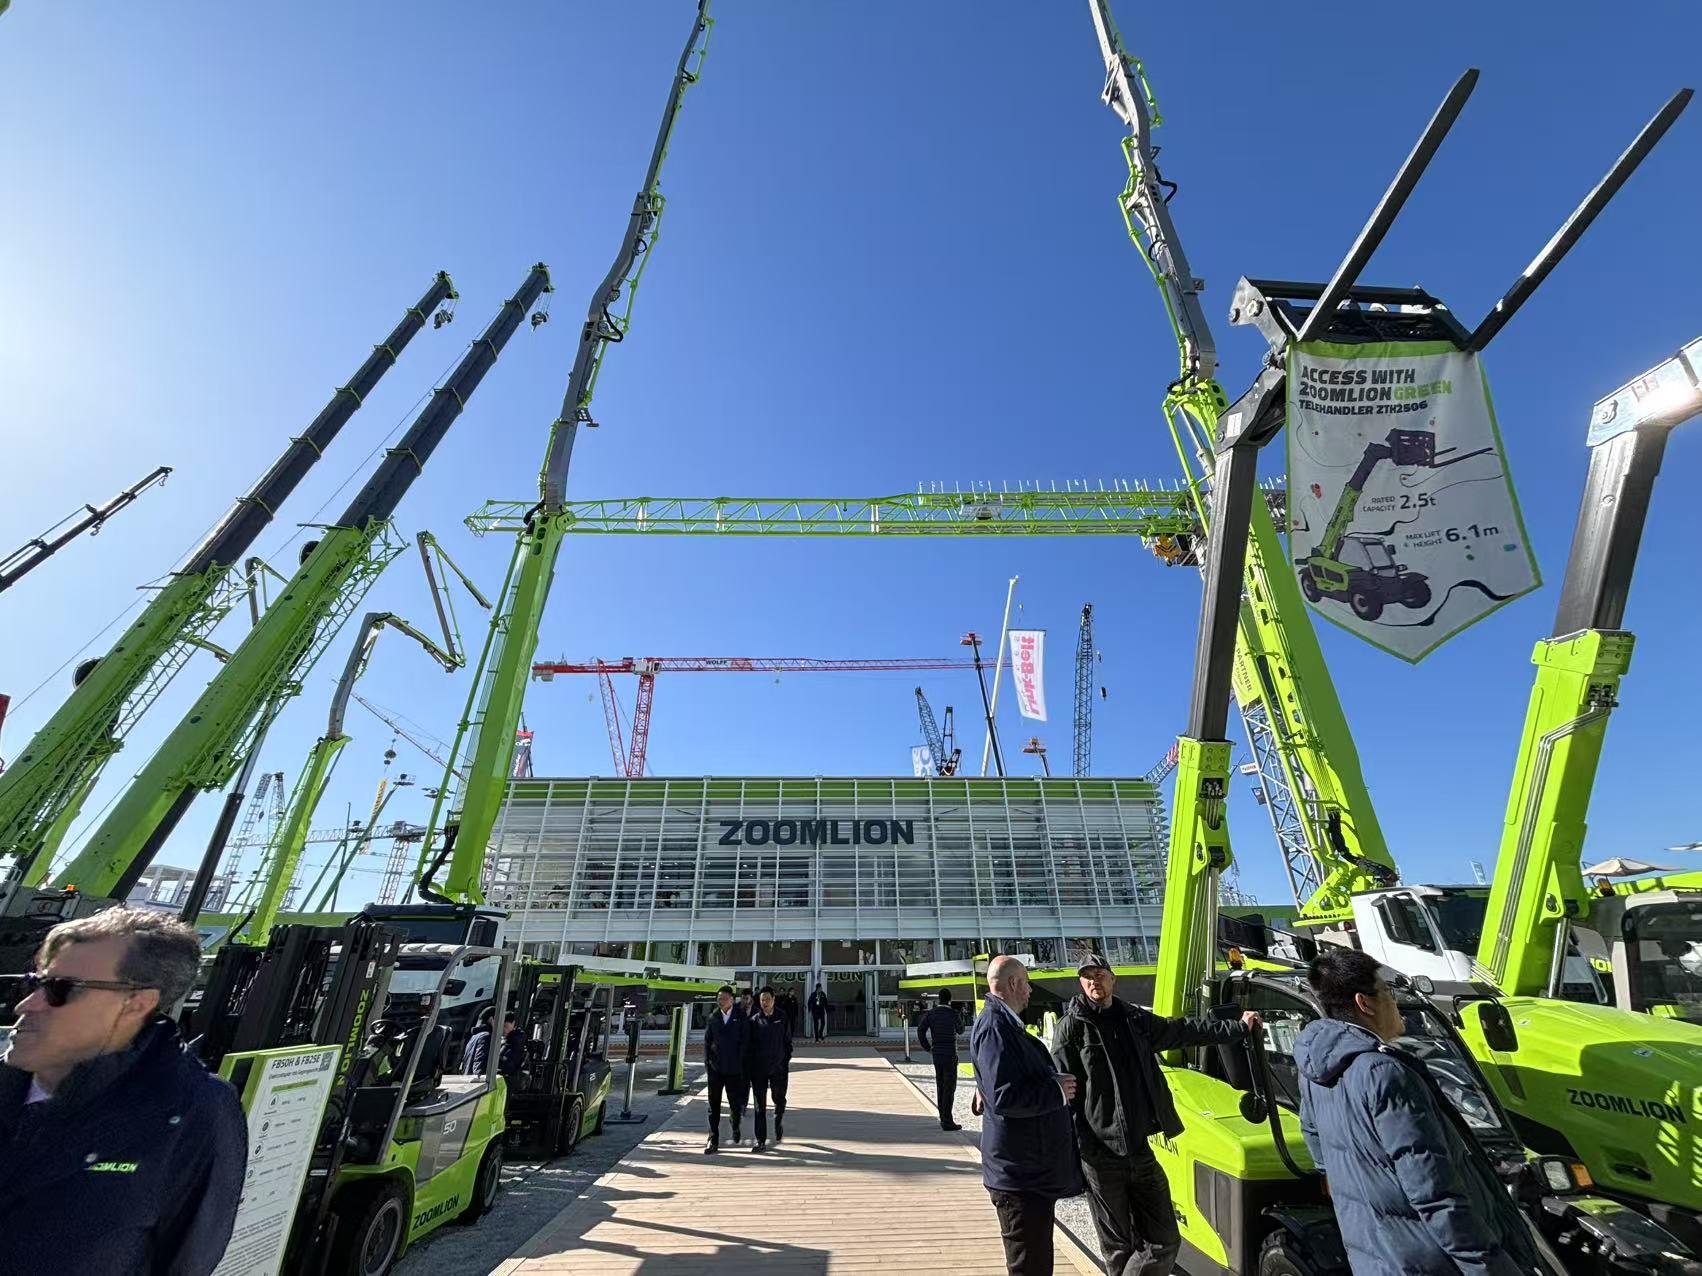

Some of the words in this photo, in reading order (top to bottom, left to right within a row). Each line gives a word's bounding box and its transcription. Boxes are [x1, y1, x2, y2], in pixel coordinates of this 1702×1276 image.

[1301, 365, 1368, 386] ACCESS
[1371, 368, 1416, 385] WITH
[1299, 381, 1392, 402] ZOOMLION
[1394, 380, 1453, 400] GREEN
[1299, 400, 1374, 416] TELEHANDLER
[1376, 400, 1428, 415] ZTH2506
[1362, 504, 1396, 513] CAPACITY
[1371, 495, 1396, 504] RATED
[718, 819, 915, 846] ZOOMLION
[337, 989, 370, 1086] ZOOMLION
[1566, 1087, 1687, 1124] ZOOMLION
[443, 1119, 457, 1135] 50
[412, 1193, 460, 1232] ZOOMLION
